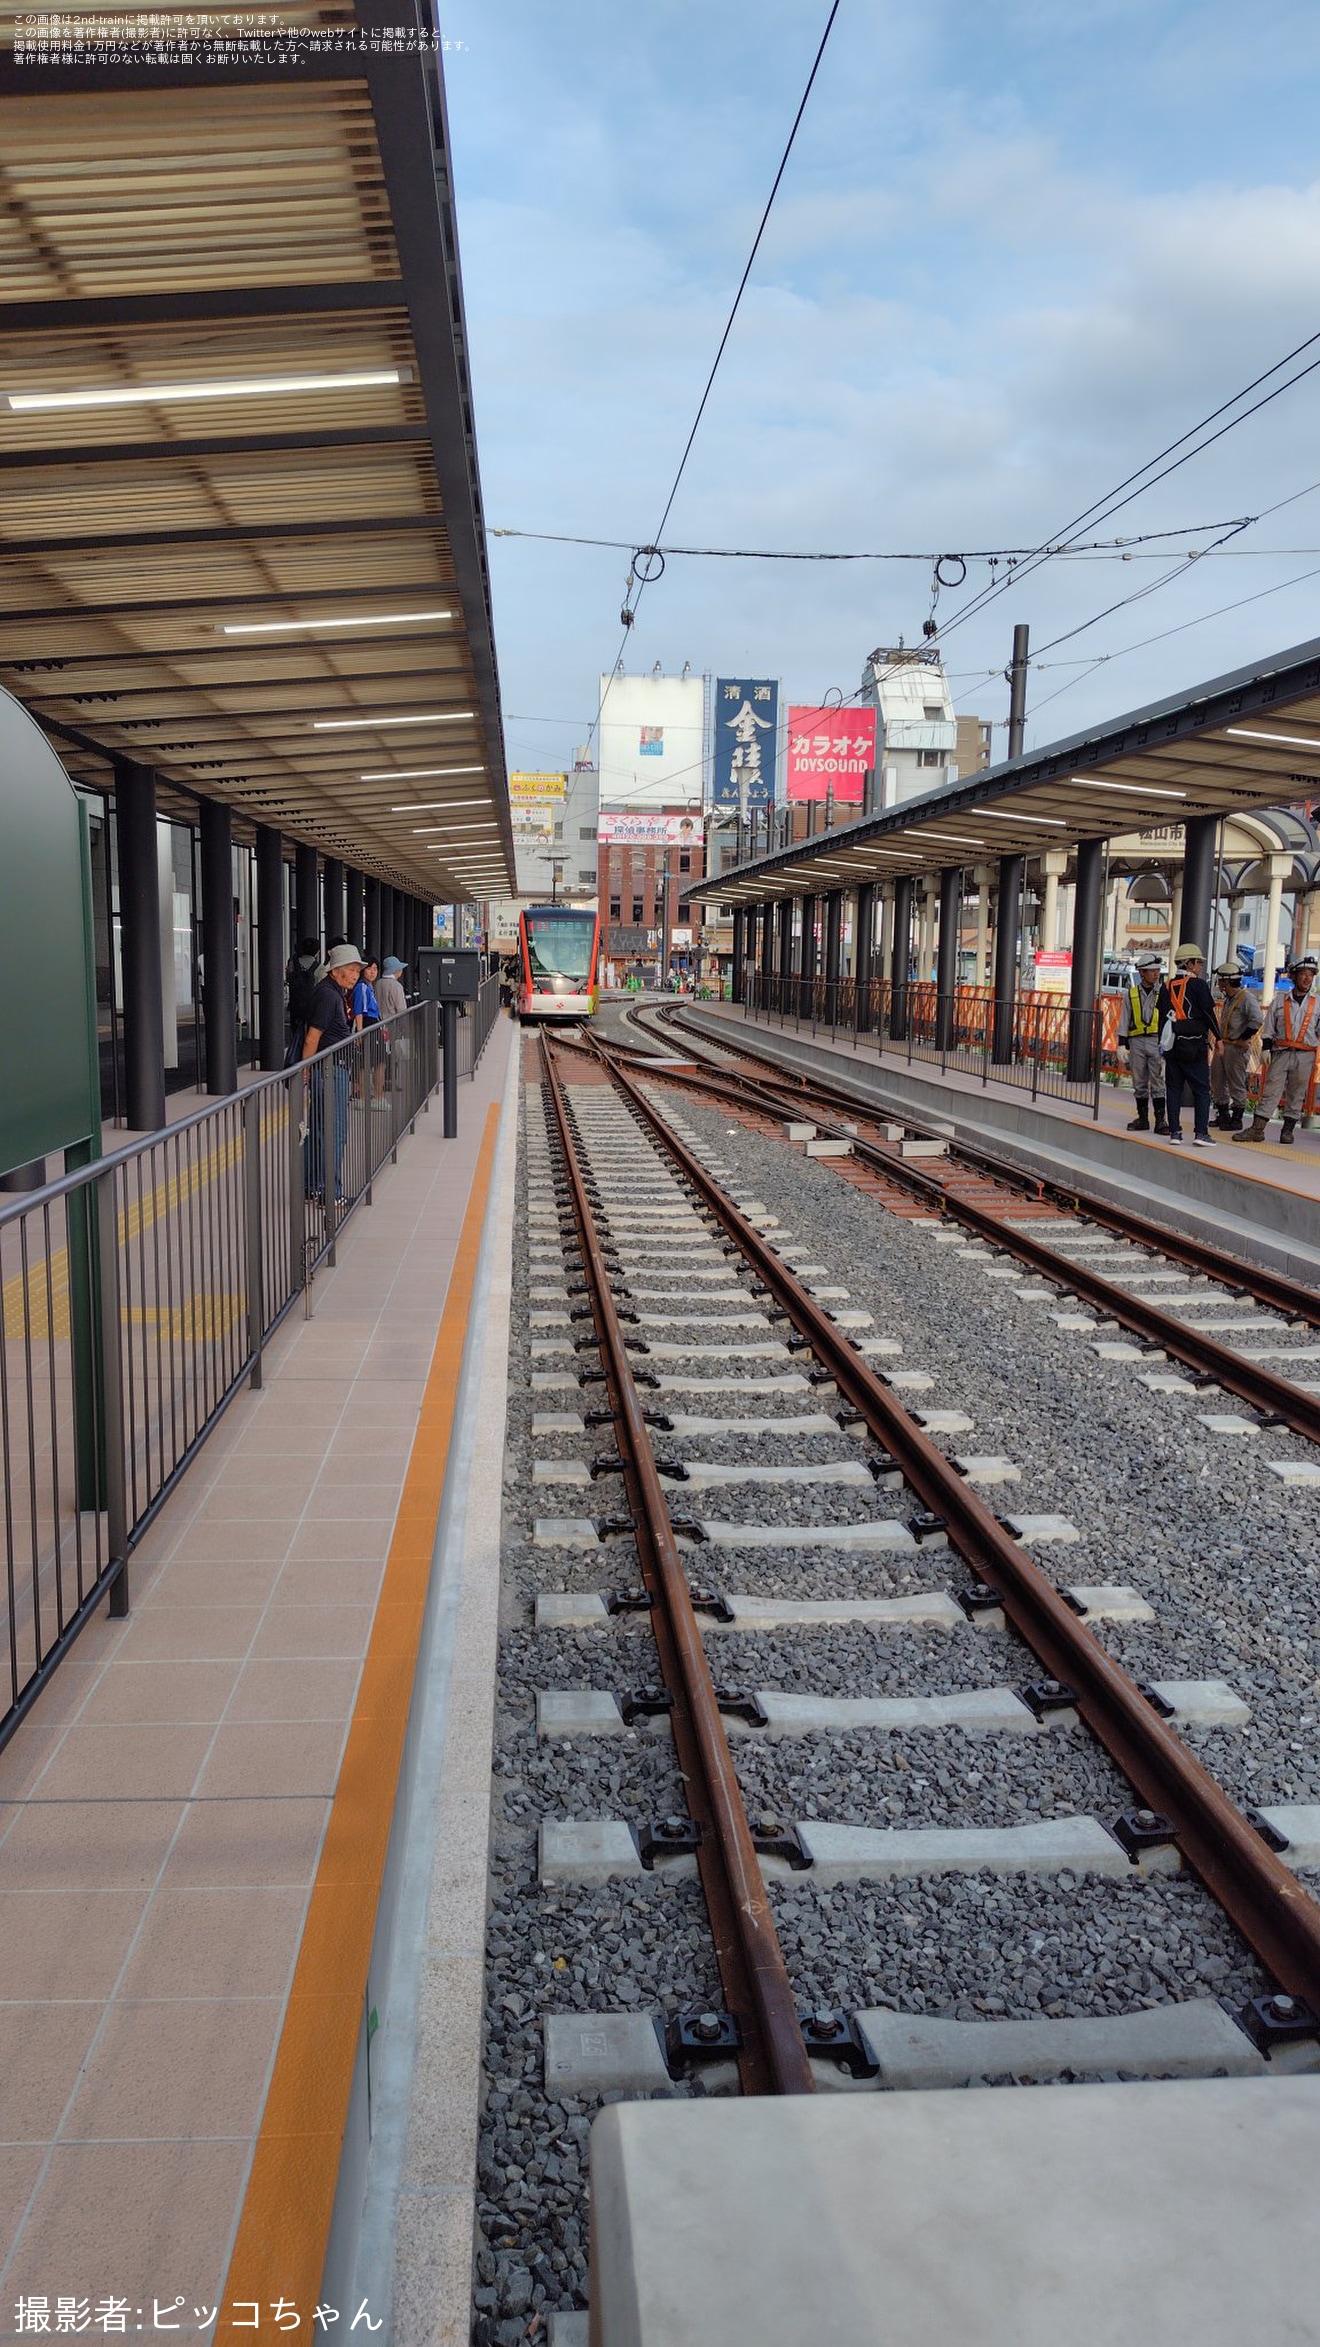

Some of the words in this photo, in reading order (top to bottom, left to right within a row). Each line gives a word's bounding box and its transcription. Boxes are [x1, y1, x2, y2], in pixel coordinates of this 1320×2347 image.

[791, 734, 873, 757] カラオケ
[794, 757, 868, 773] JOYSOUND
[721, 786, 769, 799] きんょう
[614, 825, 667, 835] 探偵事務所
